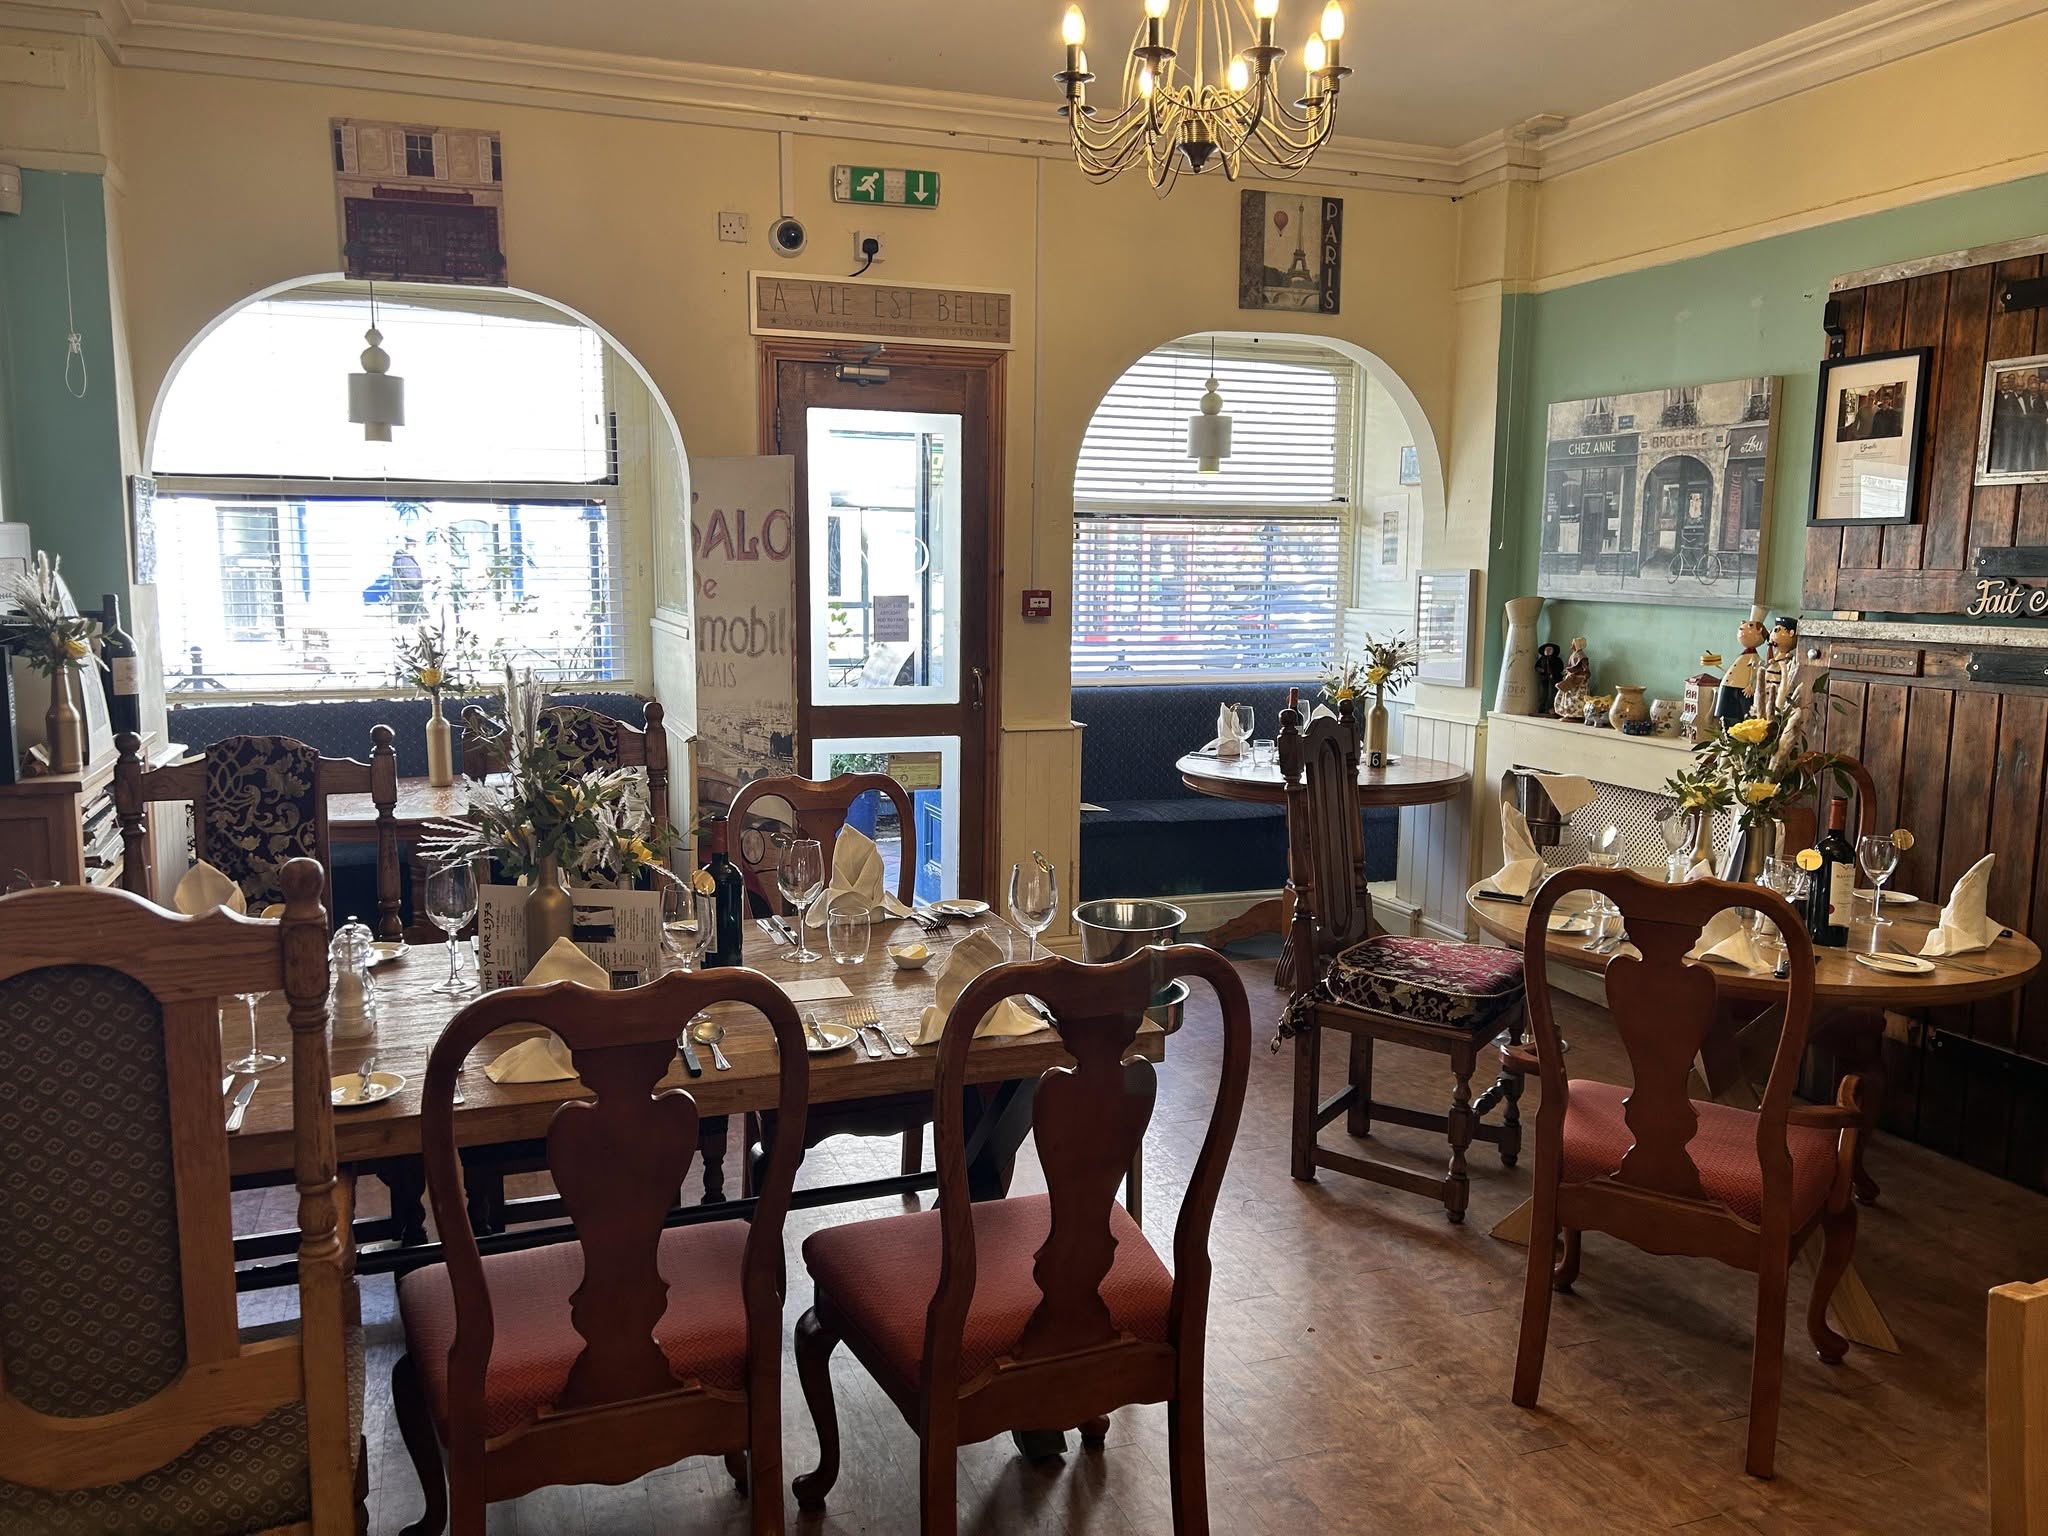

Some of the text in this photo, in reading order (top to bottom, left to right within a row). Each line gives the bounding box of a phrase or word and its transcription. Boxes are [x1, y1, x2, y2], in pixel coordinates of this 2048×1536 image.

[1325, 202, 1338, 309] PARIS
[758, 281, 1009, 328] LA VIE EST BELLE
[1568, 440, 1616, 456] CHEZ ANNE
[1729, 471, 1742, 513] SERVICE
[1967, 579, 2026, 616] Fait
[1840, 653, 1906, 670] TRUFFLES
[1373, 753, 1380, 766] 6
[483, 902, 495, 991] THE YEAR 1973
